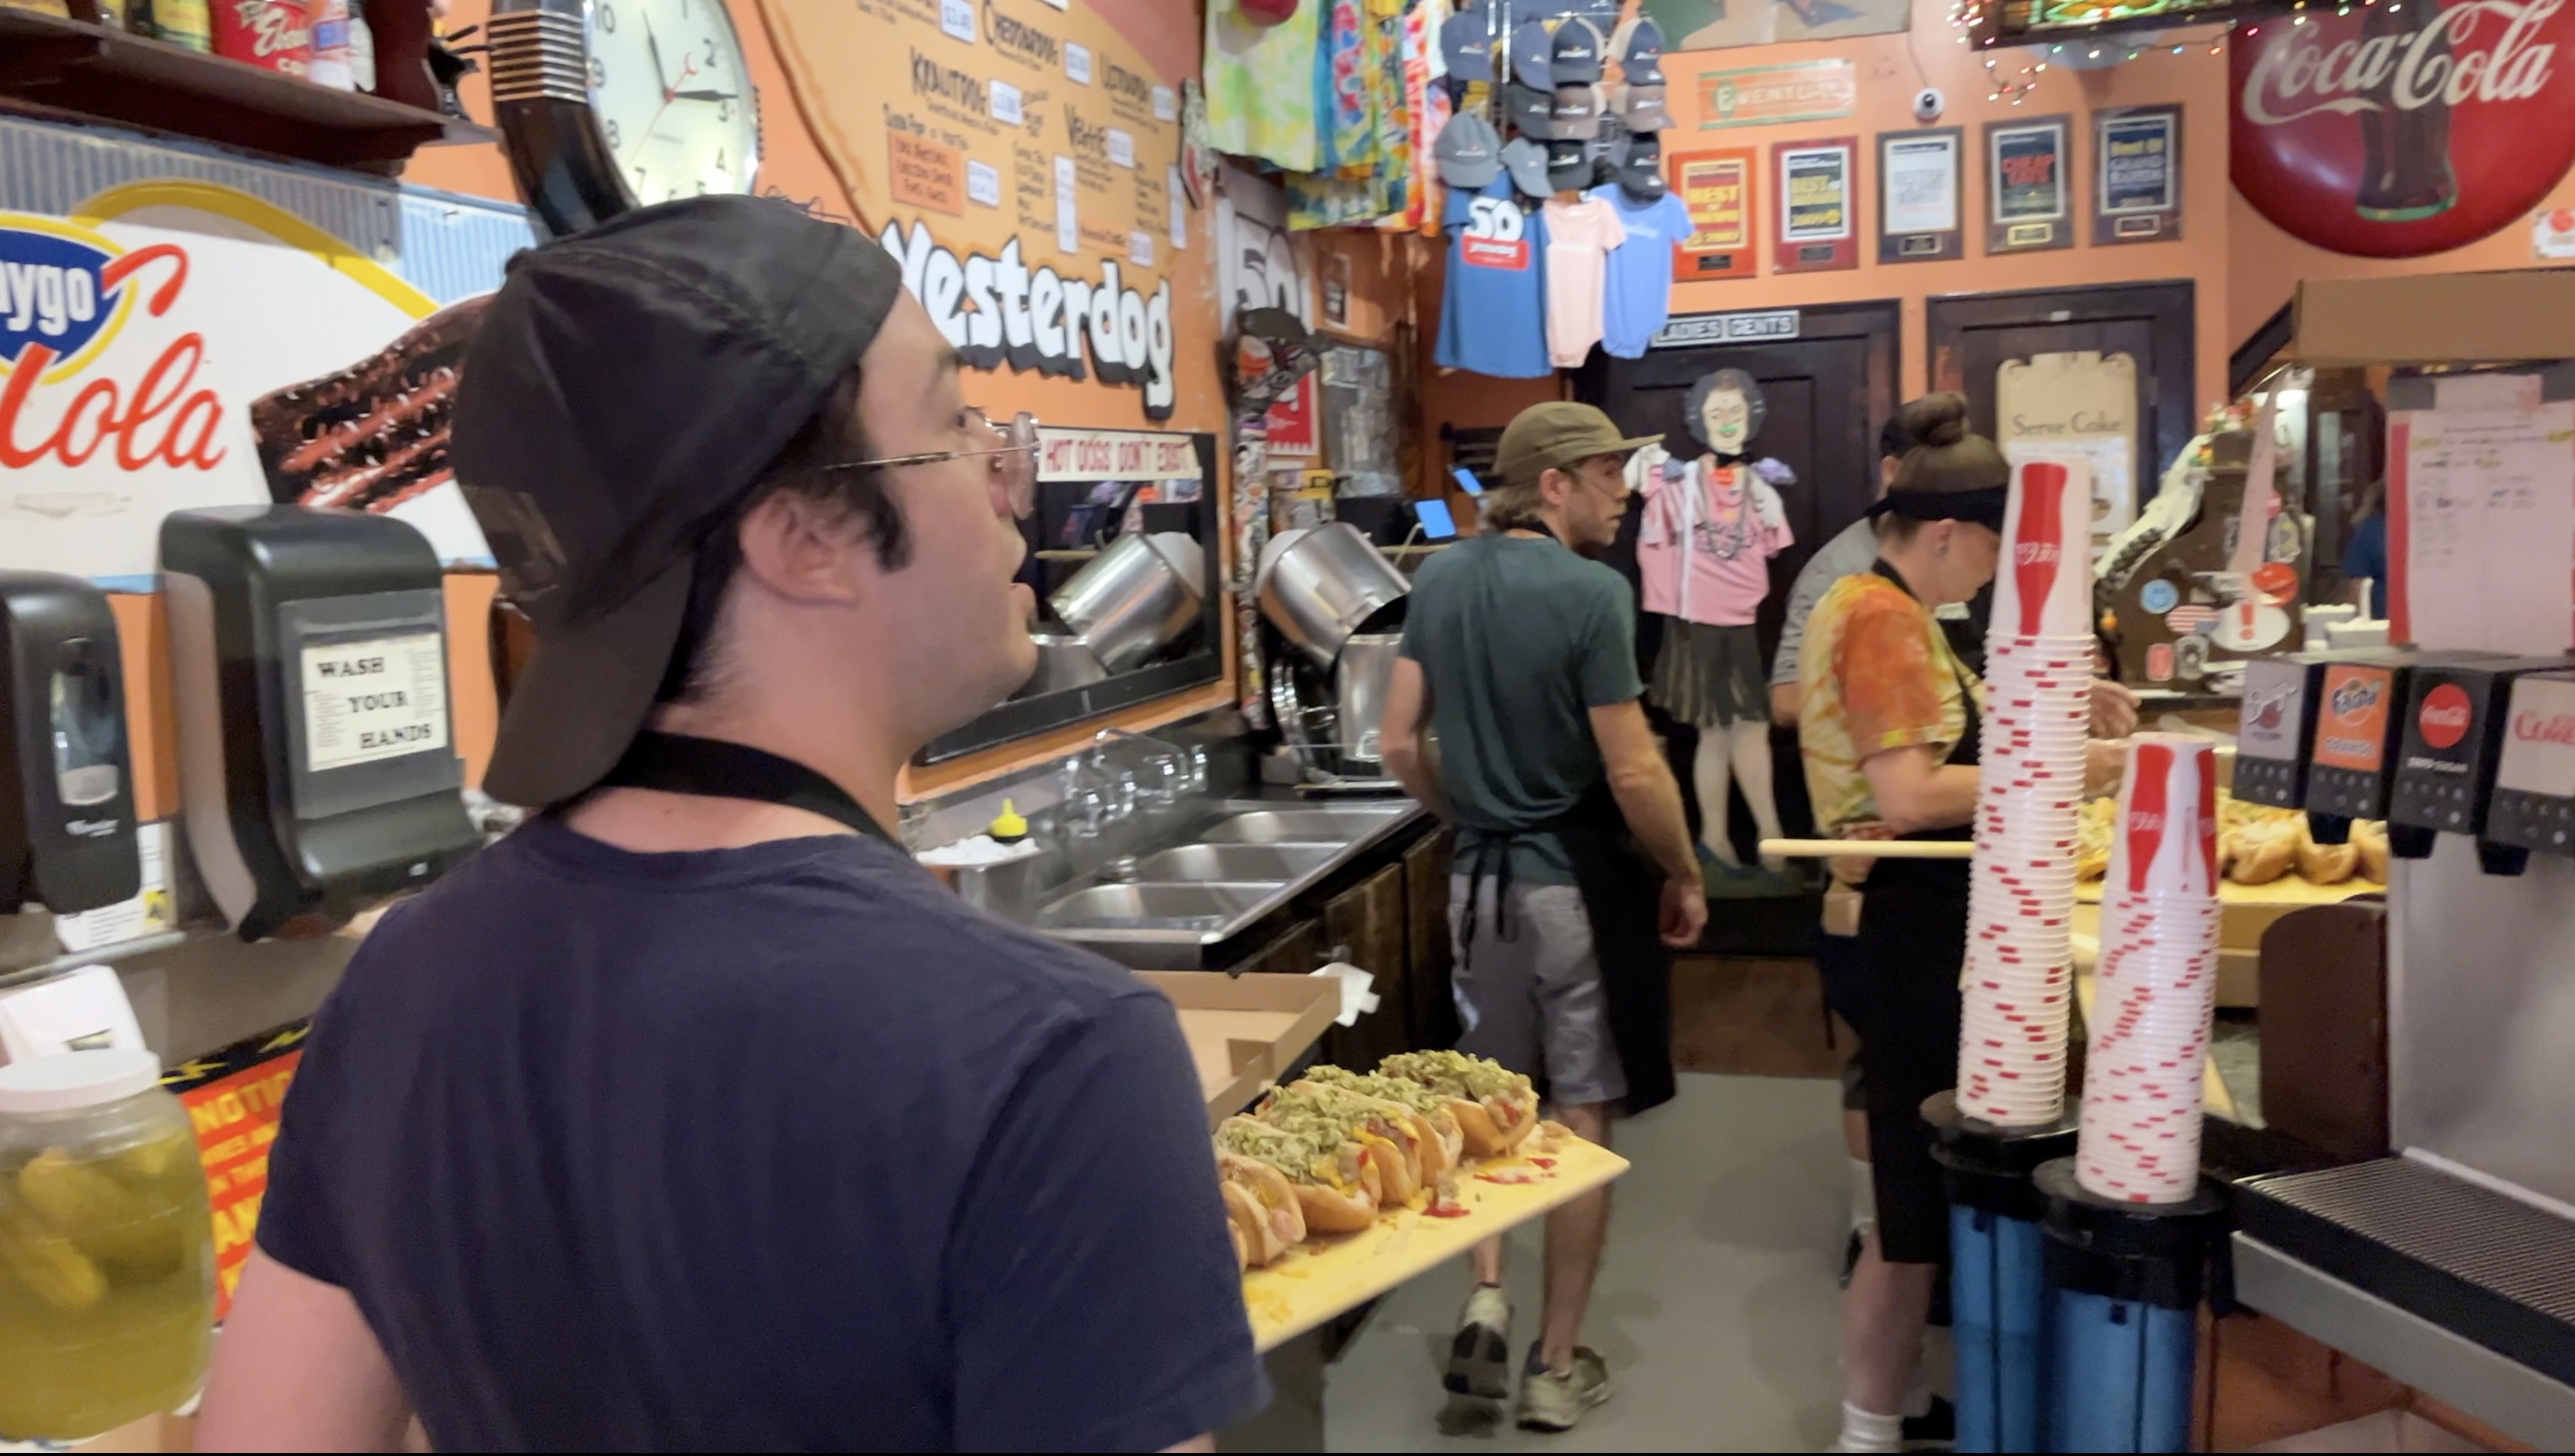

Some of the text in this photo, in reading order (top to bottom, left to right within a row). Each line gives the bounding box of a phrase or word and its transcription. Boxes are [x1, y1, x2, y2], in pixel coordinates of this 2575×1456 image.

[703, 38, 717, 67] 2
[2243, 0, 2566, 126] Coca-Cola
[1463, 196, 1524, 242] 50
[0, 262, 96, 336] ygo
[880, 218, 1174, 410] Yesterdog
[0, 243, 228, 471] Cola
[2070, 411, 2122, 434] Coke
[317, 657, 384, 678] WASH
[347, 691, 409, 713] YOUR
[360, 722, 432, 749] HANDS
